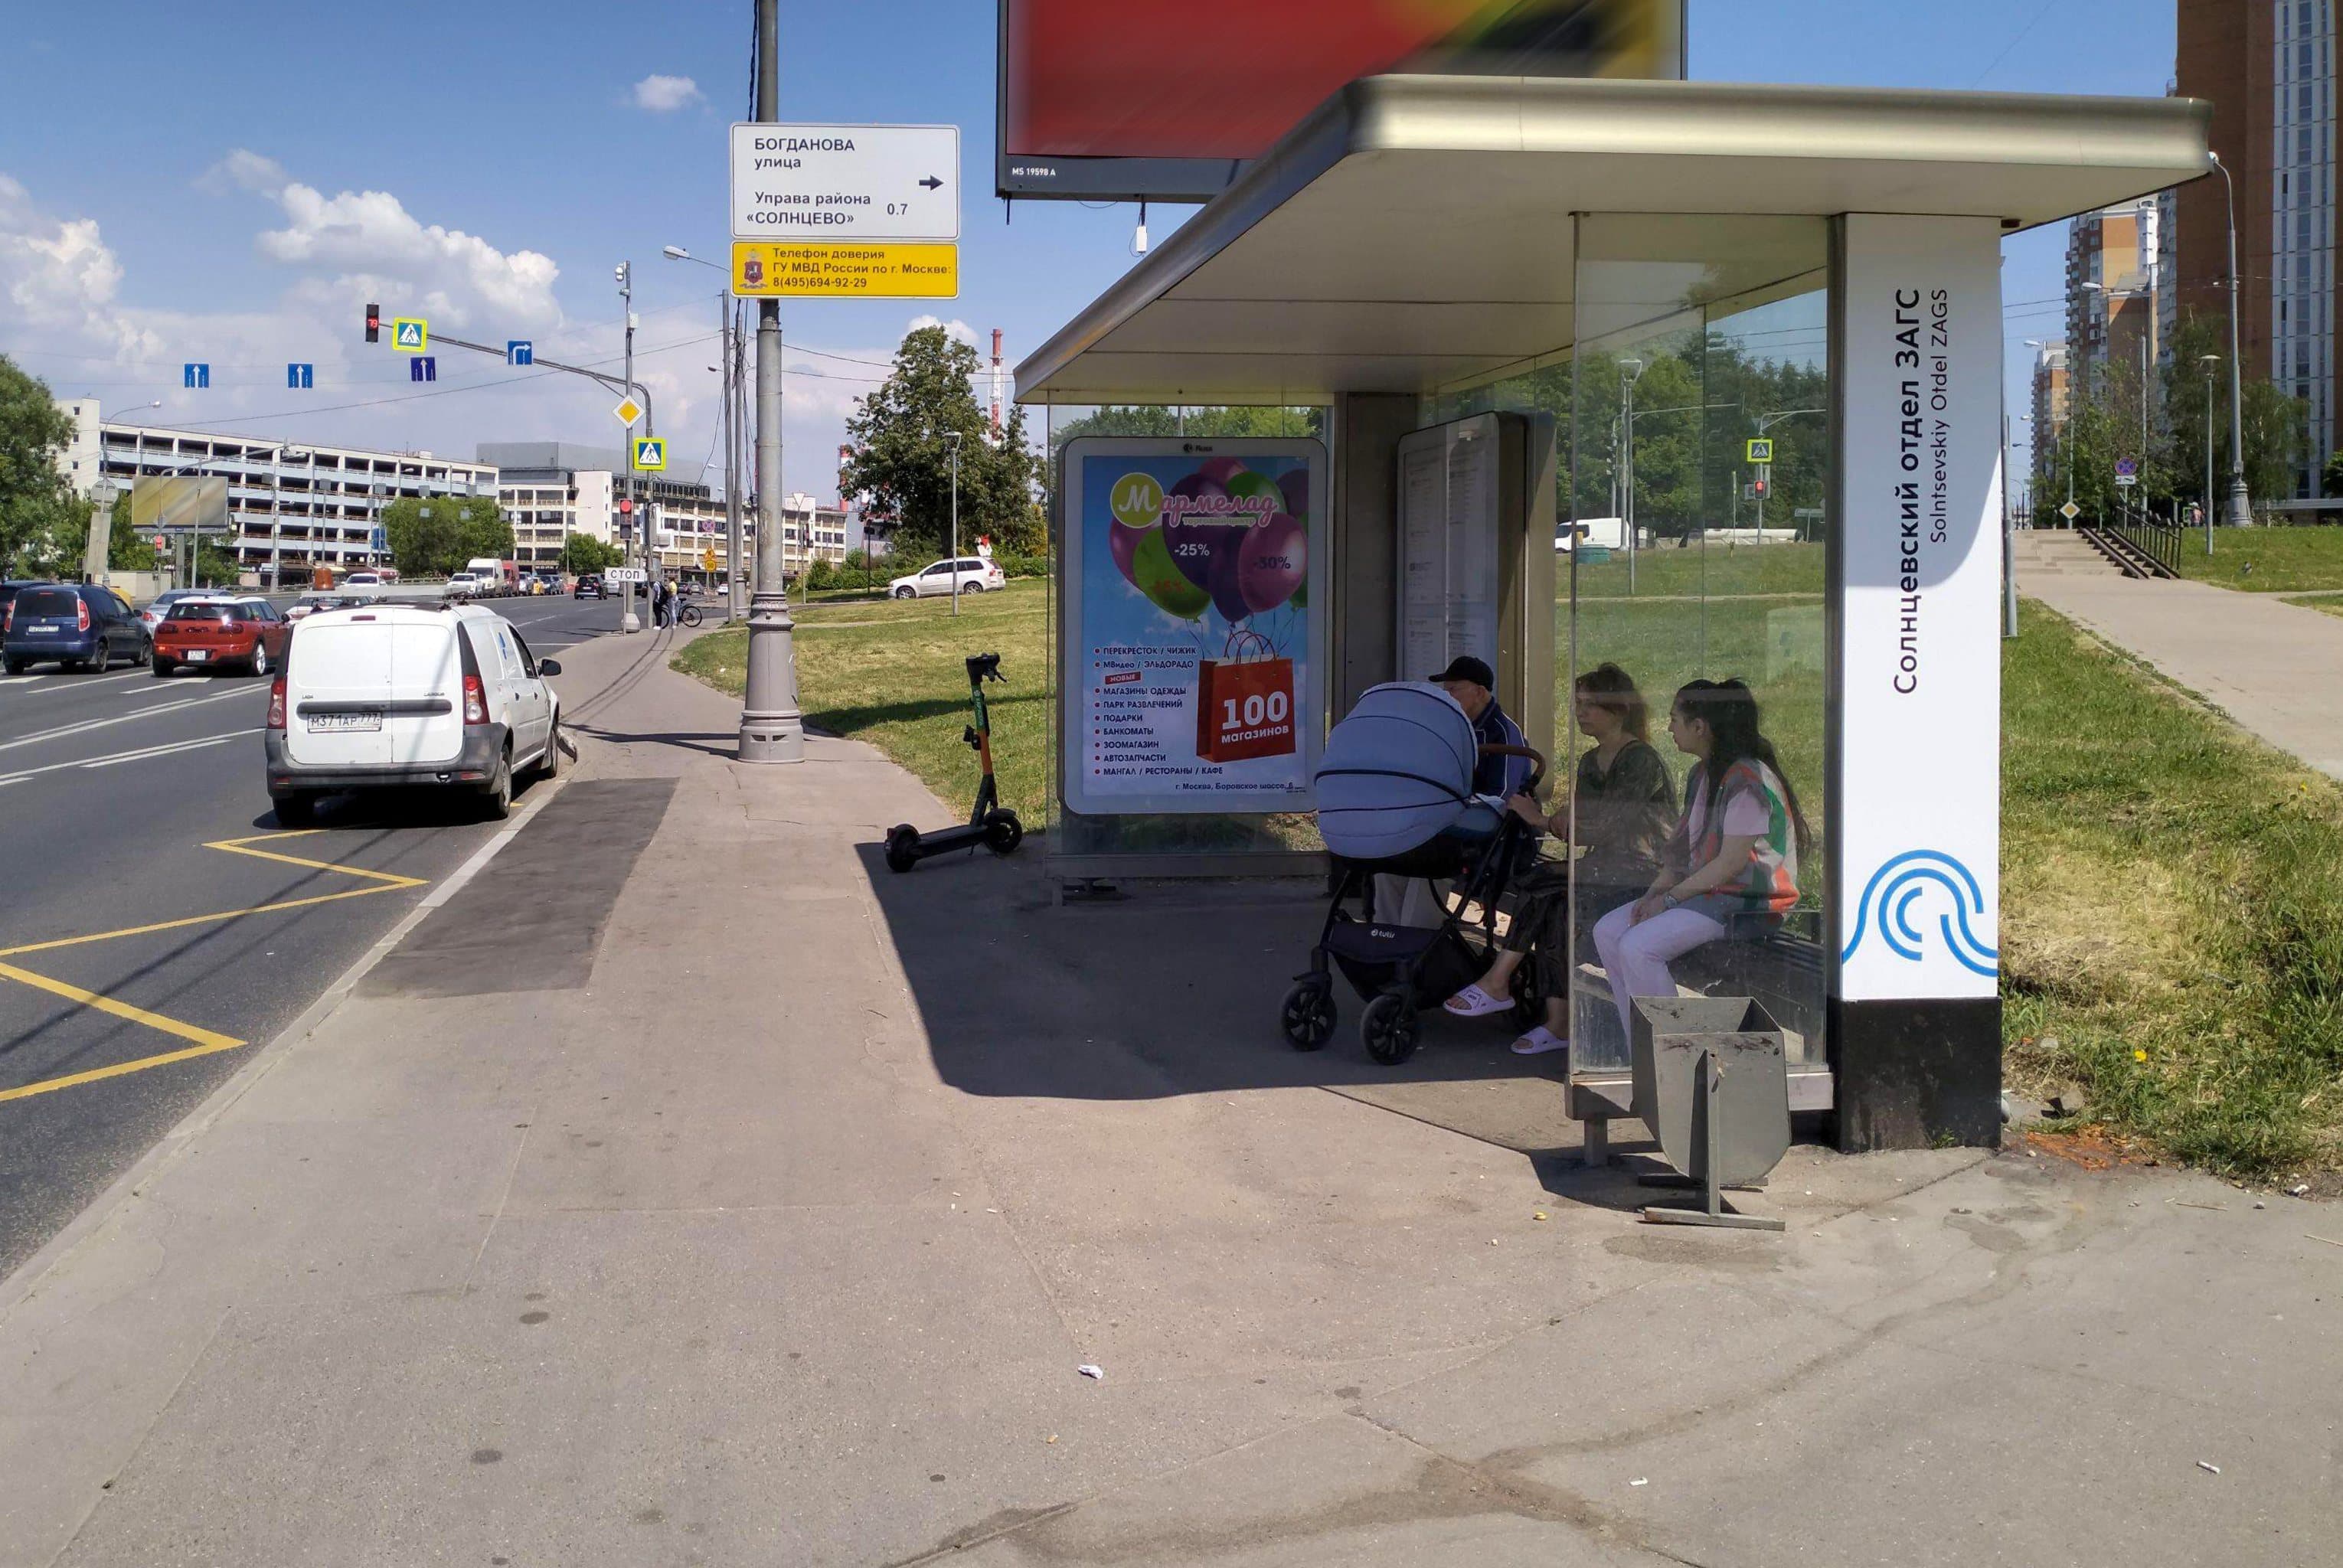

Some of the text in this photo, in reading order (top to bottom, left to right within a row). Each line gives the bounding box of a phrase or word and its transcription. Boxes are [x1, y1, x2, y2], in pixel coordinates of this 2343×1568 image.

[754, 138, 855, 152] БОГДАНОВА
[754, 157, 802, 170] улица
[1011, 167, 1024, 175] MS
[755, 191, 871, 207] Управа района
[887, 203, 908, 215] 0.7
[747, 212, 855, 226] «СОЛНЦЕВО»
[773, 248, 884, 260] Телефон доверия
[773, 263, 789, 273] ГУ
[792, 263, 819, 273] МВД
[824, 263, 868, 273] России
[902, 264, 951, 274] Москве:
[773, 277, 867, 289] 8(495)694-92-29
[1930, 289, 1950, 544] Solntsevskiy Otdel ZAGS
[1894, 289, 1923, 694] Солнцевский отдел ЗАГС
[1119, 485, 1279, 528] Мармелад
[1175, 544, 1210, 556] -25%
[610, 570, 640, 580] СТОП
[1103, 647, 1158, 655] ПЕРЕКРЕСТОК
[1144, 660, 1194, 669] ЭЛЬДОРАДО
[1109, 674, 1136, 682] НОВЫЕ
[1103, 687, 1186, 696] МАГАЗИНЫ ОДЕЖДЫ
[1103, 700, 1182, 709] ПАРК РАЗВЛЕЧЕНИЙ
[1222, 691, 1288, 730] 100
[1103, 714, 1143, 723] ПОДАРКИ
[1103, 727, 1154, 736] БАНКОМАТЫ
[1221, 725, 1289, 744] магазинов
[1103, 740, 1159, 749] ЗООМАГАЗИН
[1103, 754, 1166, 763] АВТОЗАПЧАСТИ
[1103, 767, 1137, 776] МАНГАЛ
[1145, 767, 1193, 776] РЕСТОРАНЫ
[1201, 766, 1223, 775] КАФЕ
